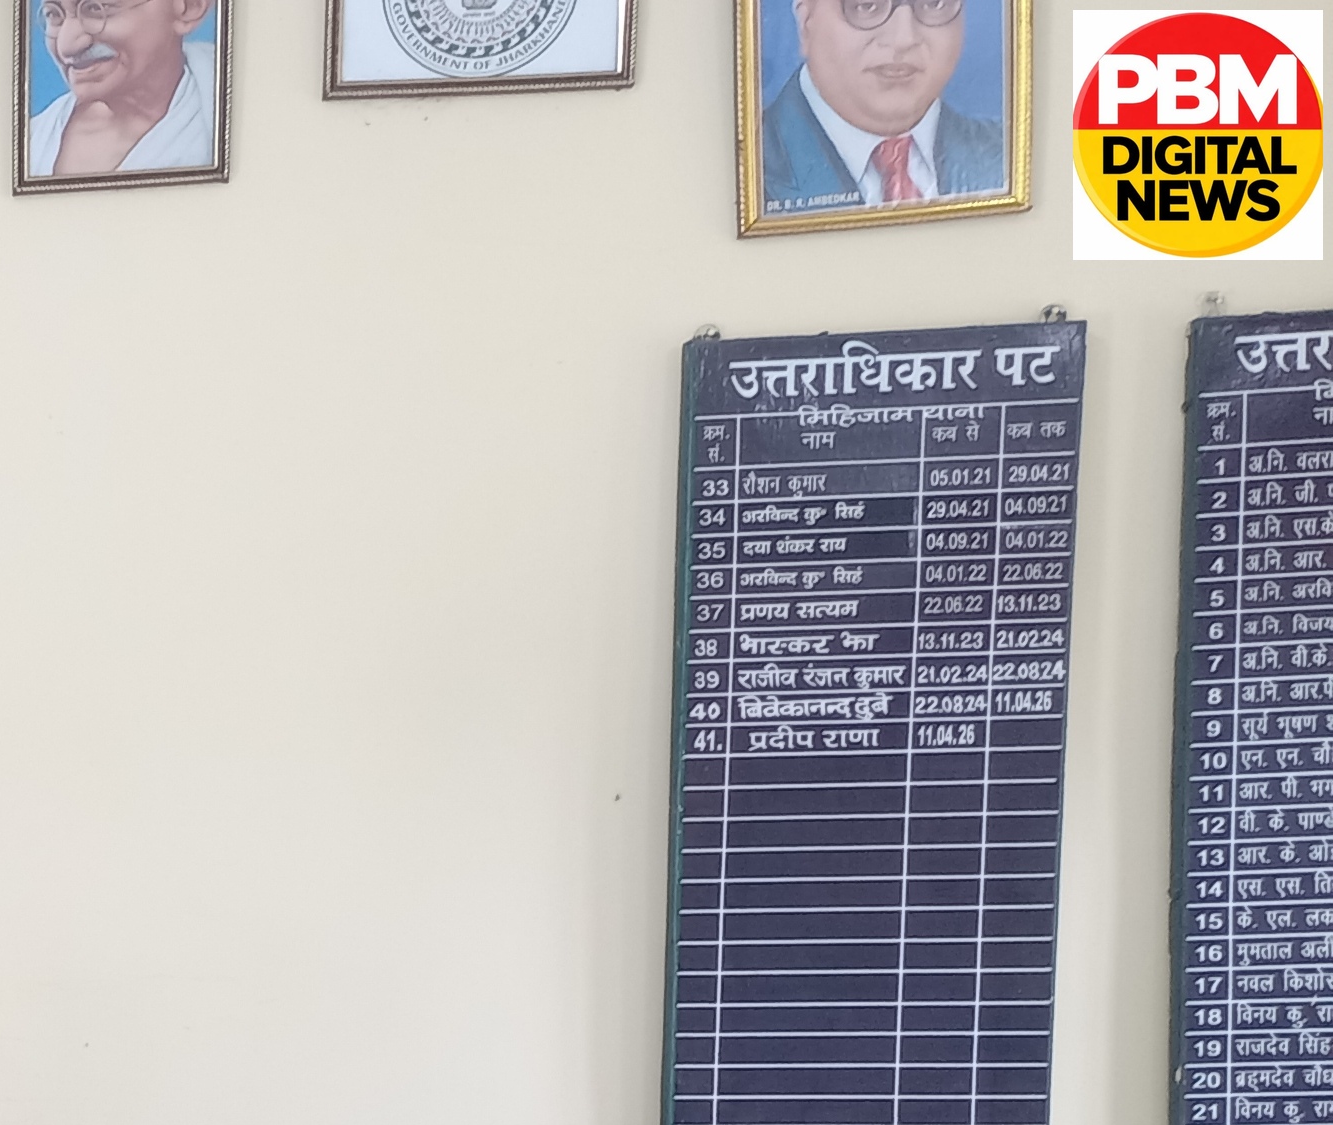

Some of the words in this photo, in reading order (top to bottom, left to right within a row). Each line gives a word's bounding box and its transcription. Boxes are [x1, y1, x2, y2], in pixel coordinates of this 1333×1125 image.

[392, 2, 468, 70] GOVERNMENT
[473, 60, 489, 70] OF
[495, 0, 568, 67] JHARKHAN
[729, 340, 983, 398] उत्तराधिकार
[994, 345, 1062, 387] पट
[800, 431, 836, 449] नाम
[965, 420, 980, 441] से
[1039, 421, 1067, 438] तक
[1215, 457, 1226, 476] 1
[702, 479, 729, 496] 33
[742, 470, 781, 494] रौशन
[787, 474, 828, 499] कुमार
[930, 467, 991, 486] 05.01.21
[1008, 462, 1070, 483] 29.04.21
[699, 508, 726, 526] 34
[926, 498, 989, 519] 29.04.21
[1005, 495, 1067, 516] 04.09.21
[1211, 491, 1228, 510] 2
[698, 541, 726, 560] 35
[743, 541, 772, 557] दया
[776, 536, 816, 554] शंकर
[819, 537, 848, 553] राय
[926, 532, 989, 550] 04.09.21
[1005, 530, 1068, 549] 04.01.22
[1211, 524, 1226, 541] 3
[696, 571, 724, 589] 36
[925, 564, 987, 583] 04.01.22
[1002, 562, 1064, 582] 22.06.22
[1209, 557, 1225, 574] 4
[696, 603, 725, 622] 37
[740, 602, 791, 621] प्रणय
[796, 600, 859, 619] सत्यम
[923, 594, 984, 614] 22.06.22
[997, 593, 1062, 613] 13.11.23
[1208, 622, 1224, 640] 6
[694, 639, 718, 657] 38
[739, 633, 834, 655] भास्कर
[918, 631, 984, 650] 13.11.23
[694, 670, 720, 689] 39
[737, 663, 799, 689] राजीव
[802, 663, 851, 688] रंजन
[853, 665, 906, 690] कुमार
[917, 664, 988, 684] 21.02.24
[689, 702, 721, 720] 40
[995, 690, 1053, 713] 11.04.26
[694, 729, 722, 751] 41.
[747, 725, 816, 751] प्रदीप
[821, 728, 880, 748] राणा
[918, 723, 975, 746] 11.04.26
[1206, 720, 1222, 738] 9
[1199, 752, 1227, 770] 10
[1198, 784, 1224, 802] 11
[1196, 881, 1223, 898] 14
[1195, 945, 1223, 962] 16
[1194, 976, 1223, 994] 17
[1236, 974, 1275, 992] नवल
[1194, 1040, 1222, 1057] 19
[1235, 1033, 1291, 1056] राजदेव
